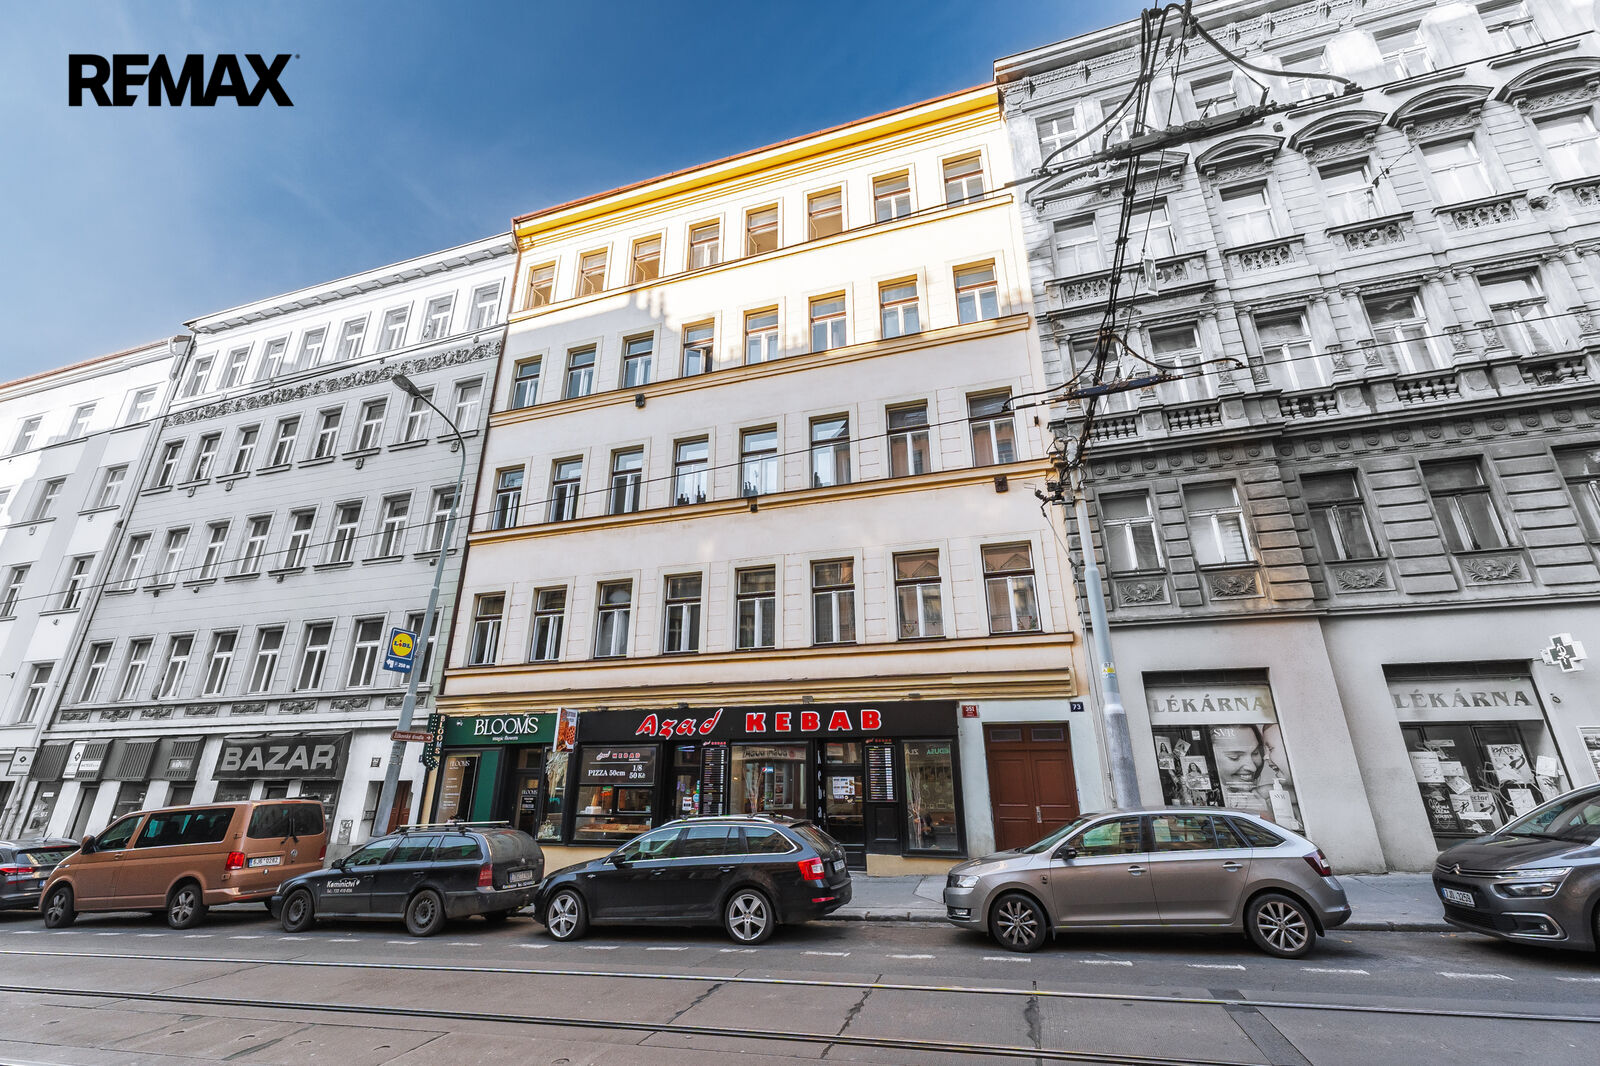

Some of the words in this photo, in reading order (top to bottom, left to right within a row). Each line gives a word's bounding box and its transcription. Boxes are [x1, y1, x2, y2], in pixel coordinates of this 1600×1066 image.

[1153, 694, 1267, 713] LÉKÁRNA
[1393, 688, 1533, 709] LÉKÁRNA
[474, 717, 538, 735] BLOOMS
[635, 708, 723, 740] Azad
[745, 709, 882, 733] KEBAB
[1213, 728, 1235, 737] SVR
[220, 744, 336, 771] BAZAR
[588, 769, 608, 777] PIZZA
[609, 769, 626, 777] 50cm
